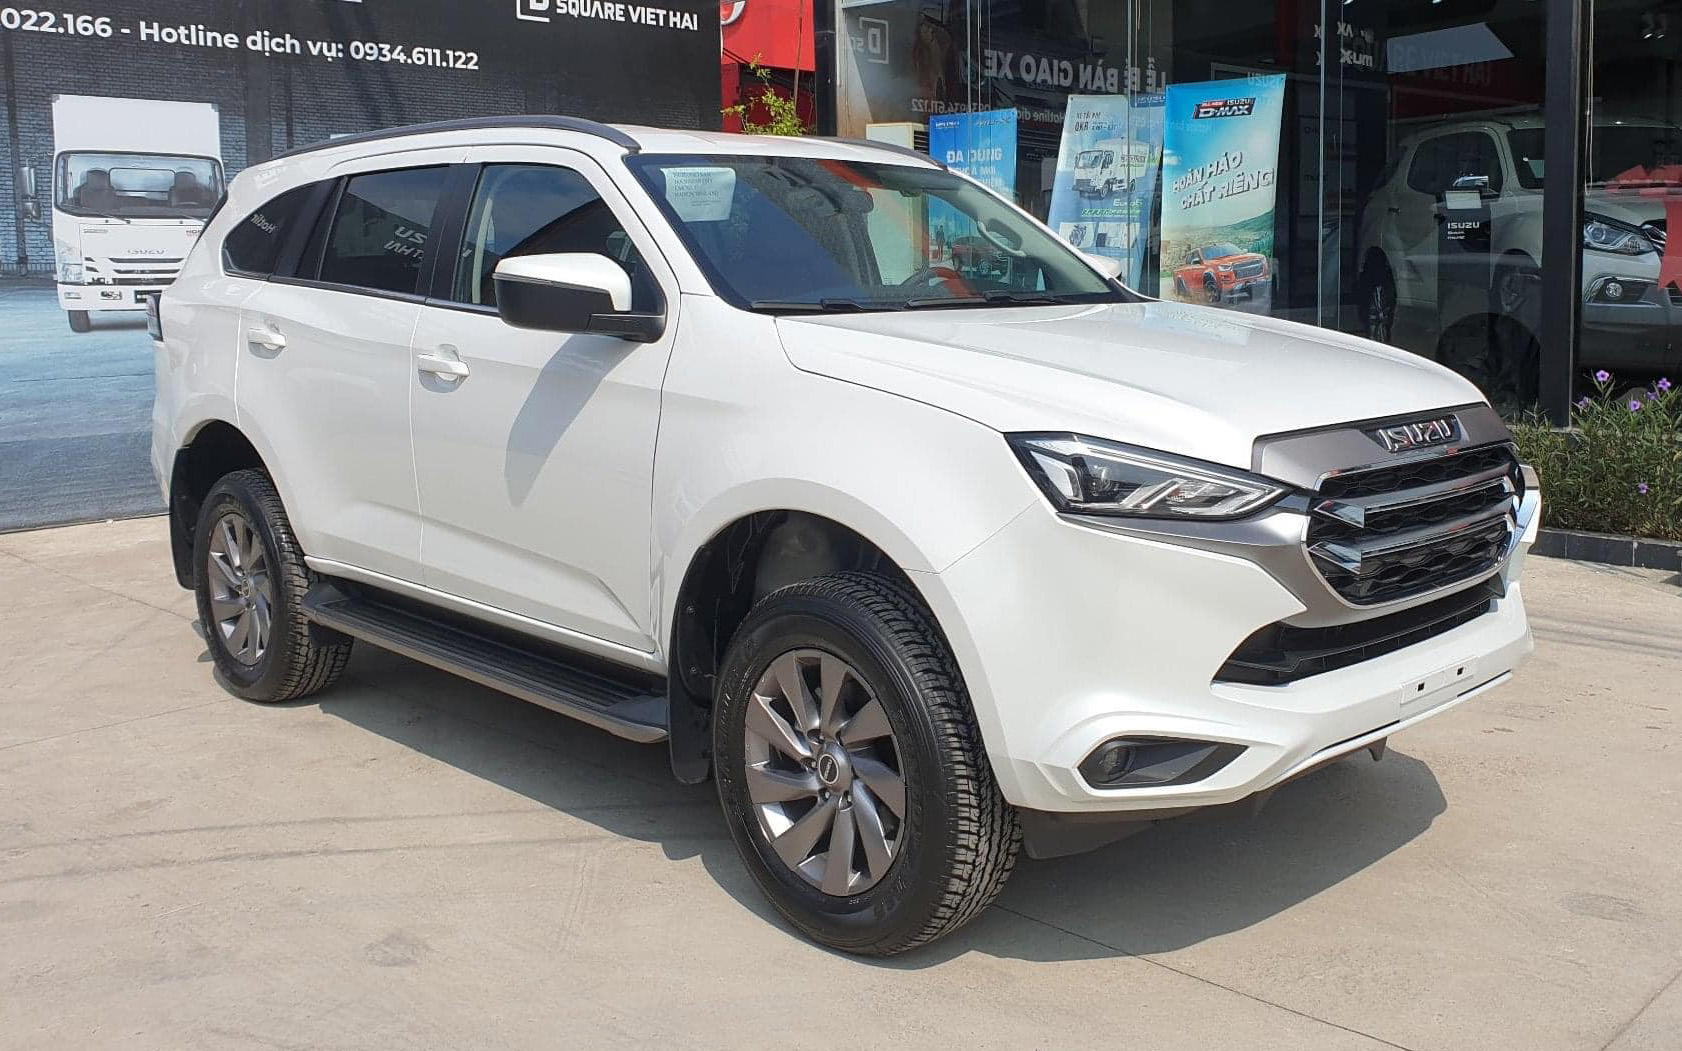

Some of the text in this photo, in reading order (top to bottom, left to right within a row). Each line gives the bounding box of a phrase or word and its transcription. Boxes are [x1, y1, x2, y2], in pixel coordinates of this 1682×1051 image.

[556, 0, 698, 31] SQUARE VIET HAI
[140, 21, 239, 49] Hotline
[246, 30, 301, 58] dịch
[307, 41, 345, 61] vụ:
[350, 40, 479, 71] 0934.611.122
[1199, 105, 1250, 118] D-MAX
[1447, 221, 1480, 229] ISUZU
[1378, 418, 1452, 452] ISUZU
